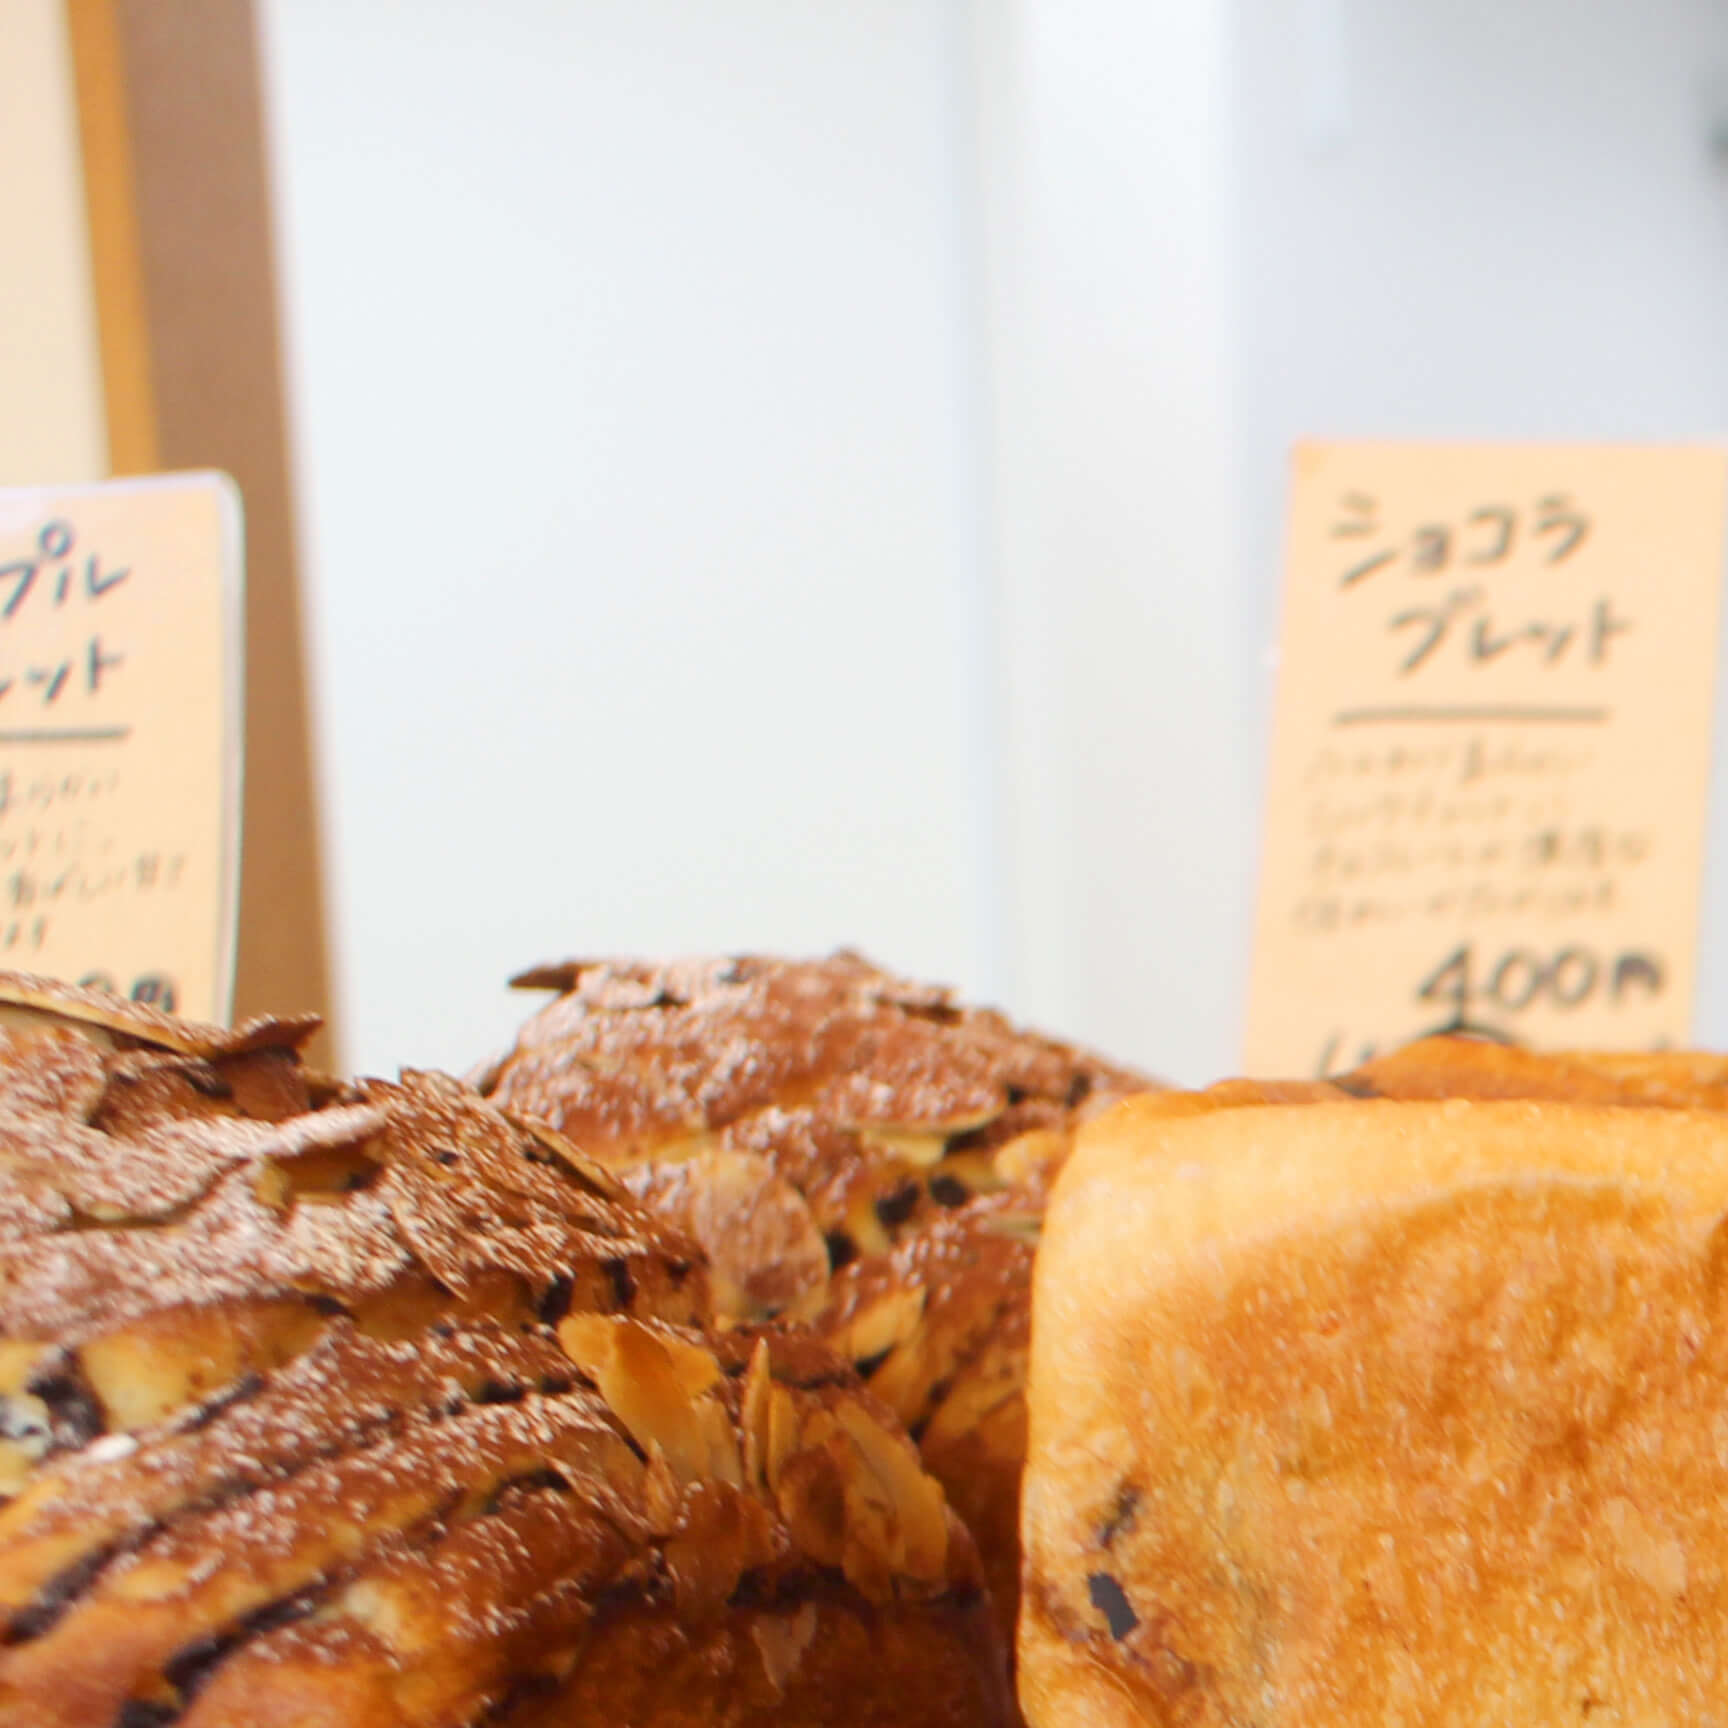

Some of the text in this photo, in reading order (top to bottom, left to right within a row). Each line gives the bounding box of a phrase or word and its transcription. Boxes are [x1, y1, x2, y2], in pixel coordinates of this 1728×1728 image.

[1330, 494, 1589, 592] ショコラ
[0, 635, 126, 704] ット
[1389, 586, 1632, 678] ブレット
[1416, 941, 1665, 1025] 400円
